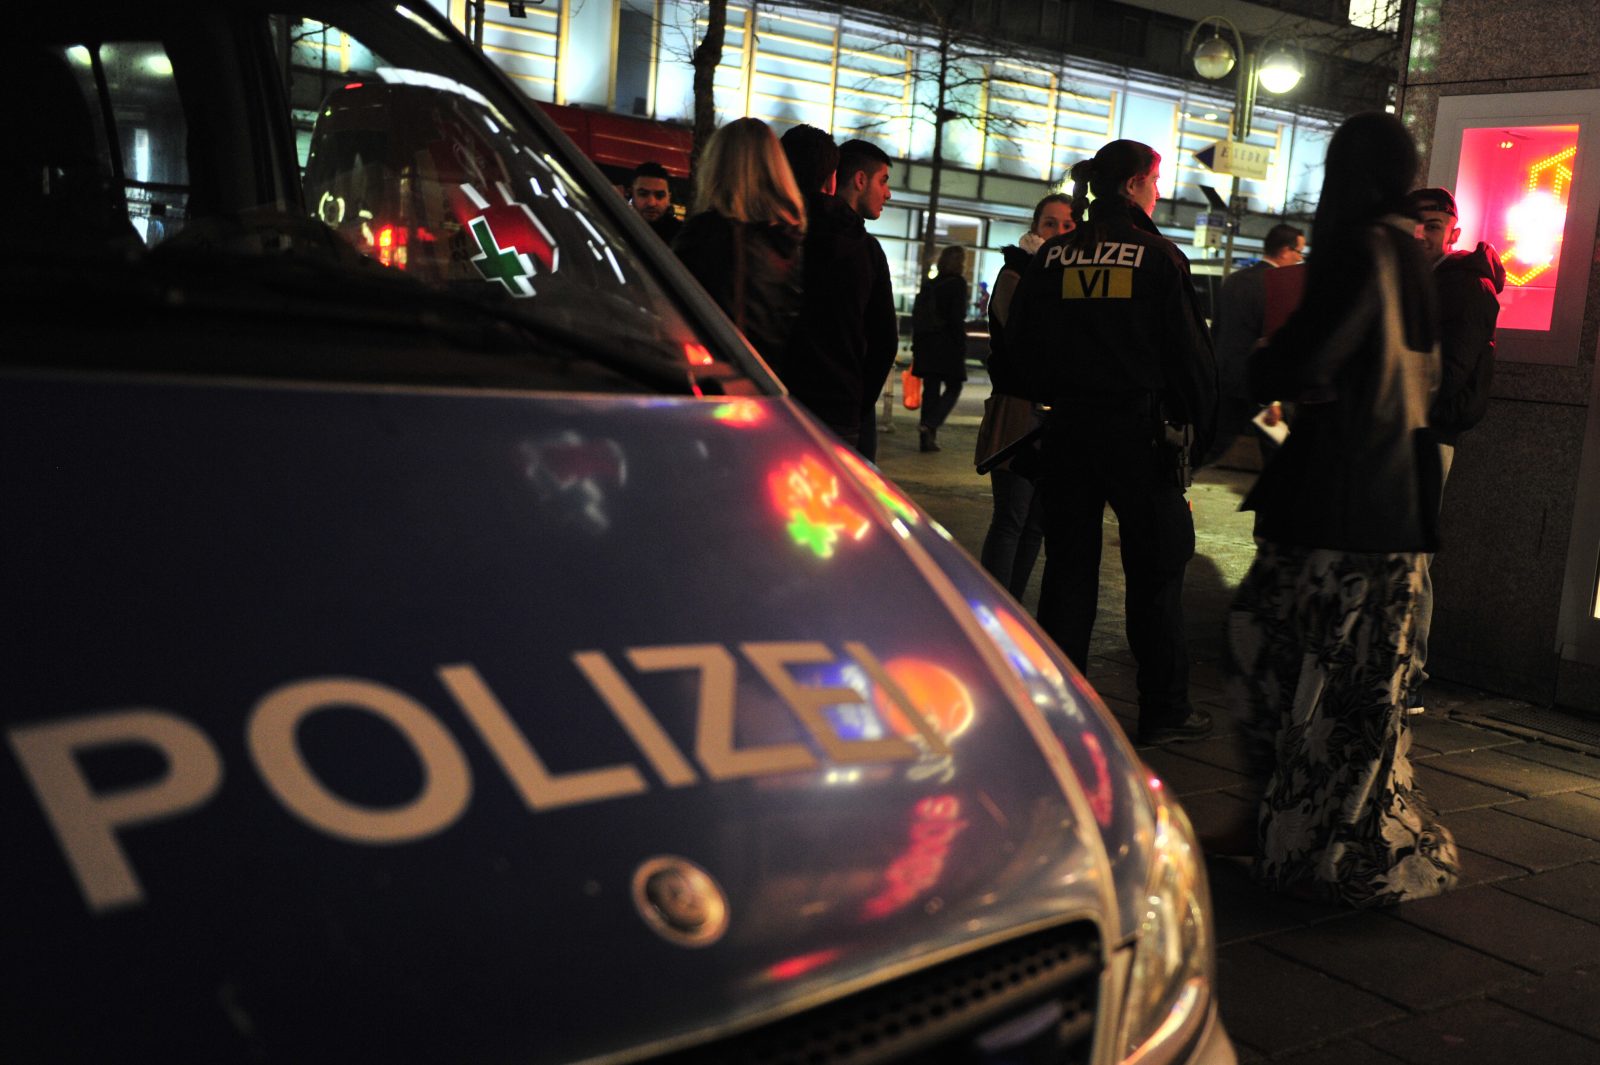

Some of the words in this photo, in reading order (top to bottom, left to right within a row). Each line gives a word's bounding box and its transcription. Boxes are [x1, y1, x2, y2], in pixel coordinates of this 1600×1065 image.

[1044, 242, 1145, 268] POLIZEI
[1078, 269, 1110, 297] VI
[7, 641, 951, 914] POLIZEI
